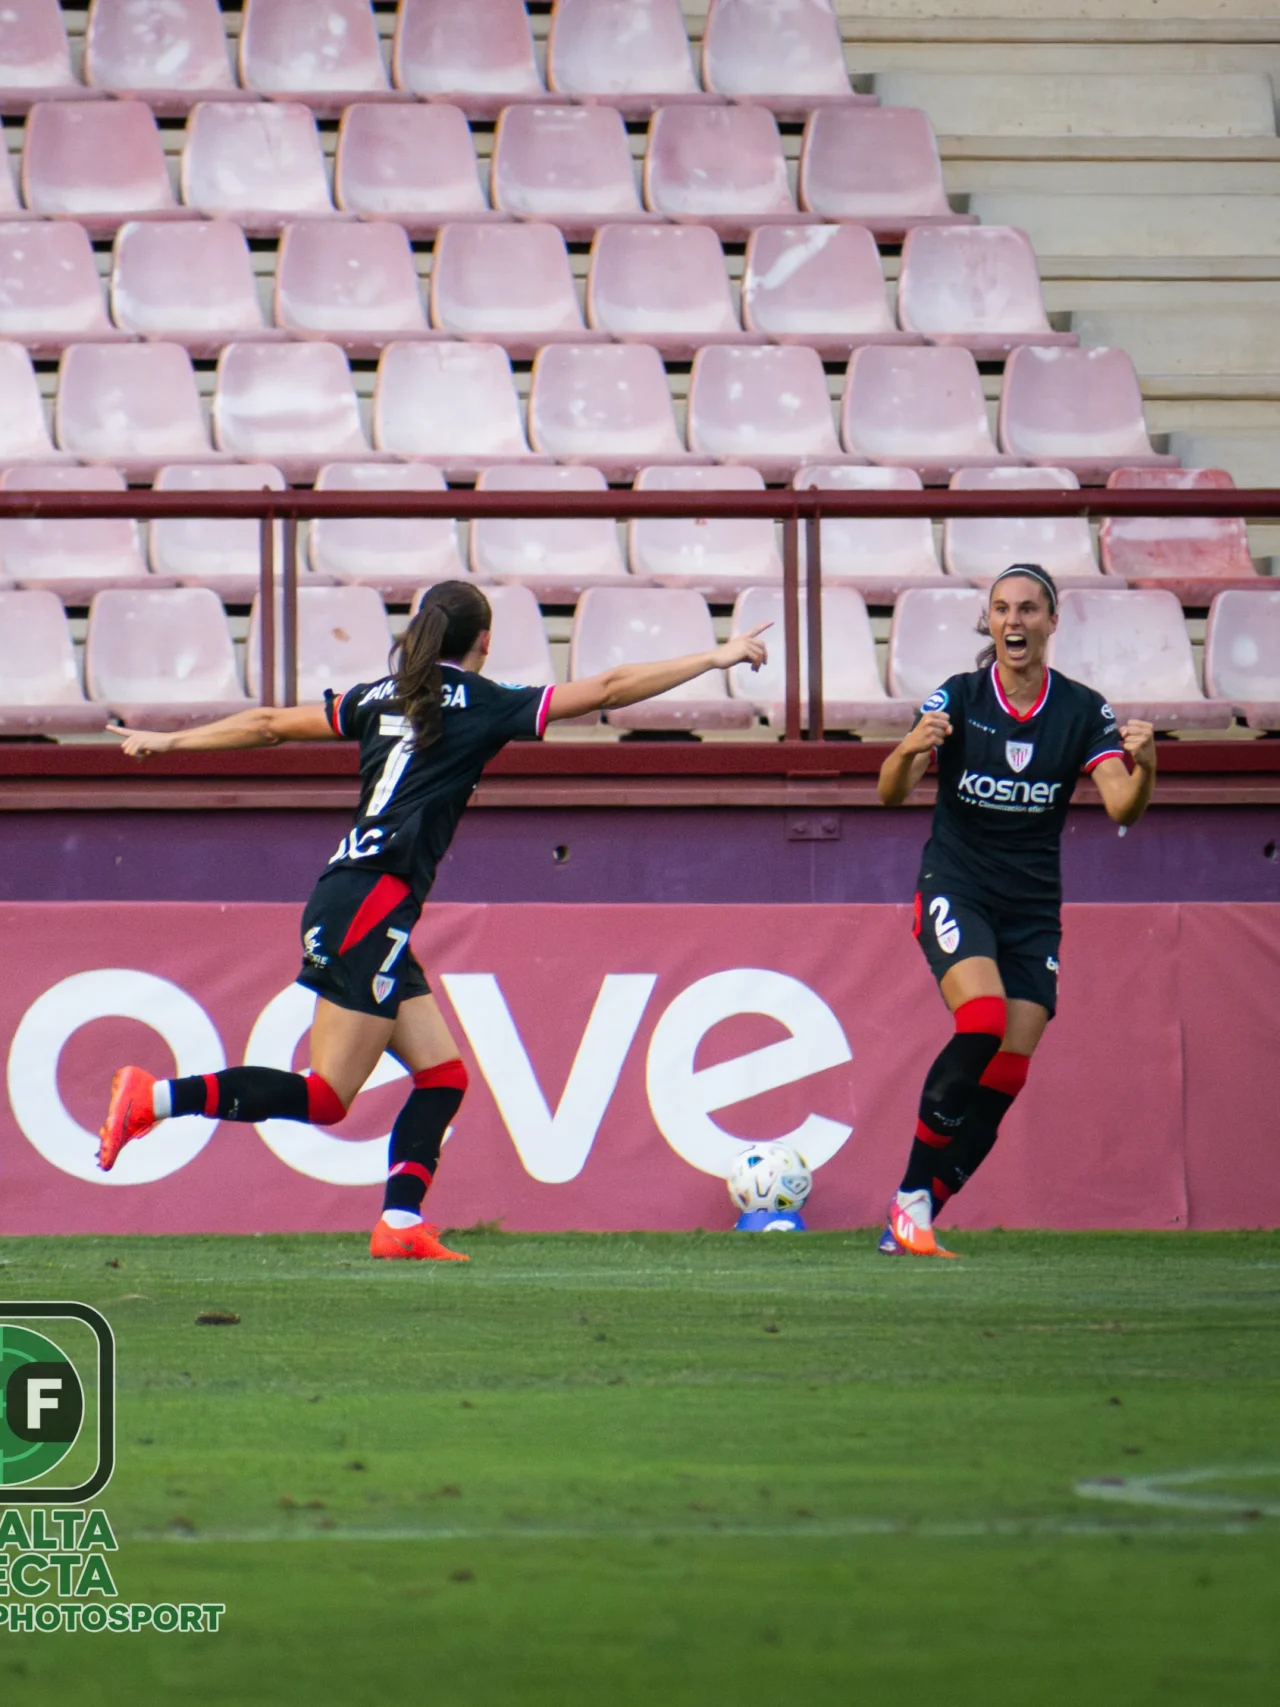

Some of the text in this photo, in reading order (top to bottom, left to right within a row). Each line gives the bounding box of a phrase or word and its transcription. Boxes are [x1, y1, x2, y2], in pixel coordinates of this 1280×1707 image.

[365, 713, 418, 818] 7
[958, 769, 1062, 803] kosner
[929, 897, 957, 936] 2
[379, 927, 408, 972] 7
